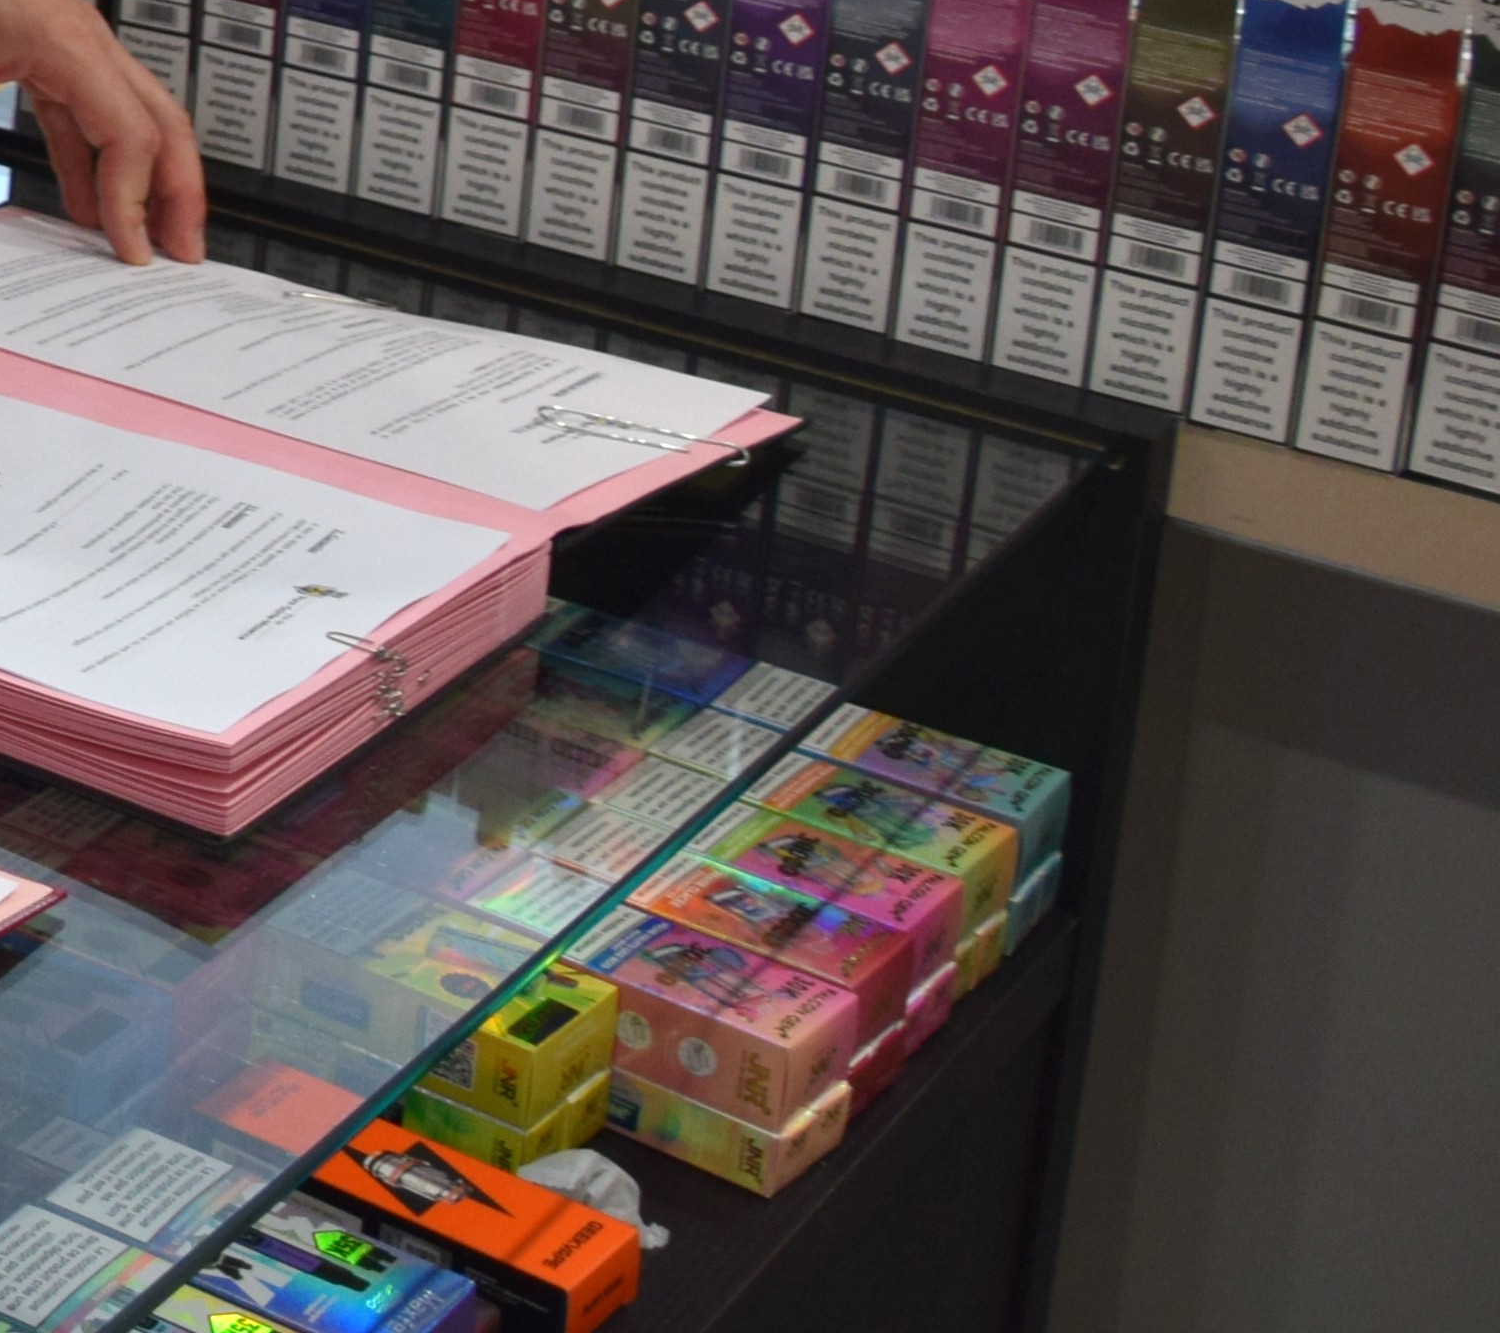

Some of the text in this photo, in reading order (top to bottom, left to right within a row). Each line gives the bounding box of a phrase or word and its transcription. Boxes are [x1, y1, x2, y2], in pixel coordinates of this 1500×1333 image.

[1320, 331, 1404, 362] This product
[1329, 352, 1386, 375] contains
[1329, 369, 1381, 390] nicotine
[1320, 382, 1386, 407] which is a
[1331, 402, 1370, 422] highly
[1320, 417, 1378, 439] addictive
[1311, 432, 1380, 456] substance
[542, 1221, 604, 1270] GEEKVAPE
